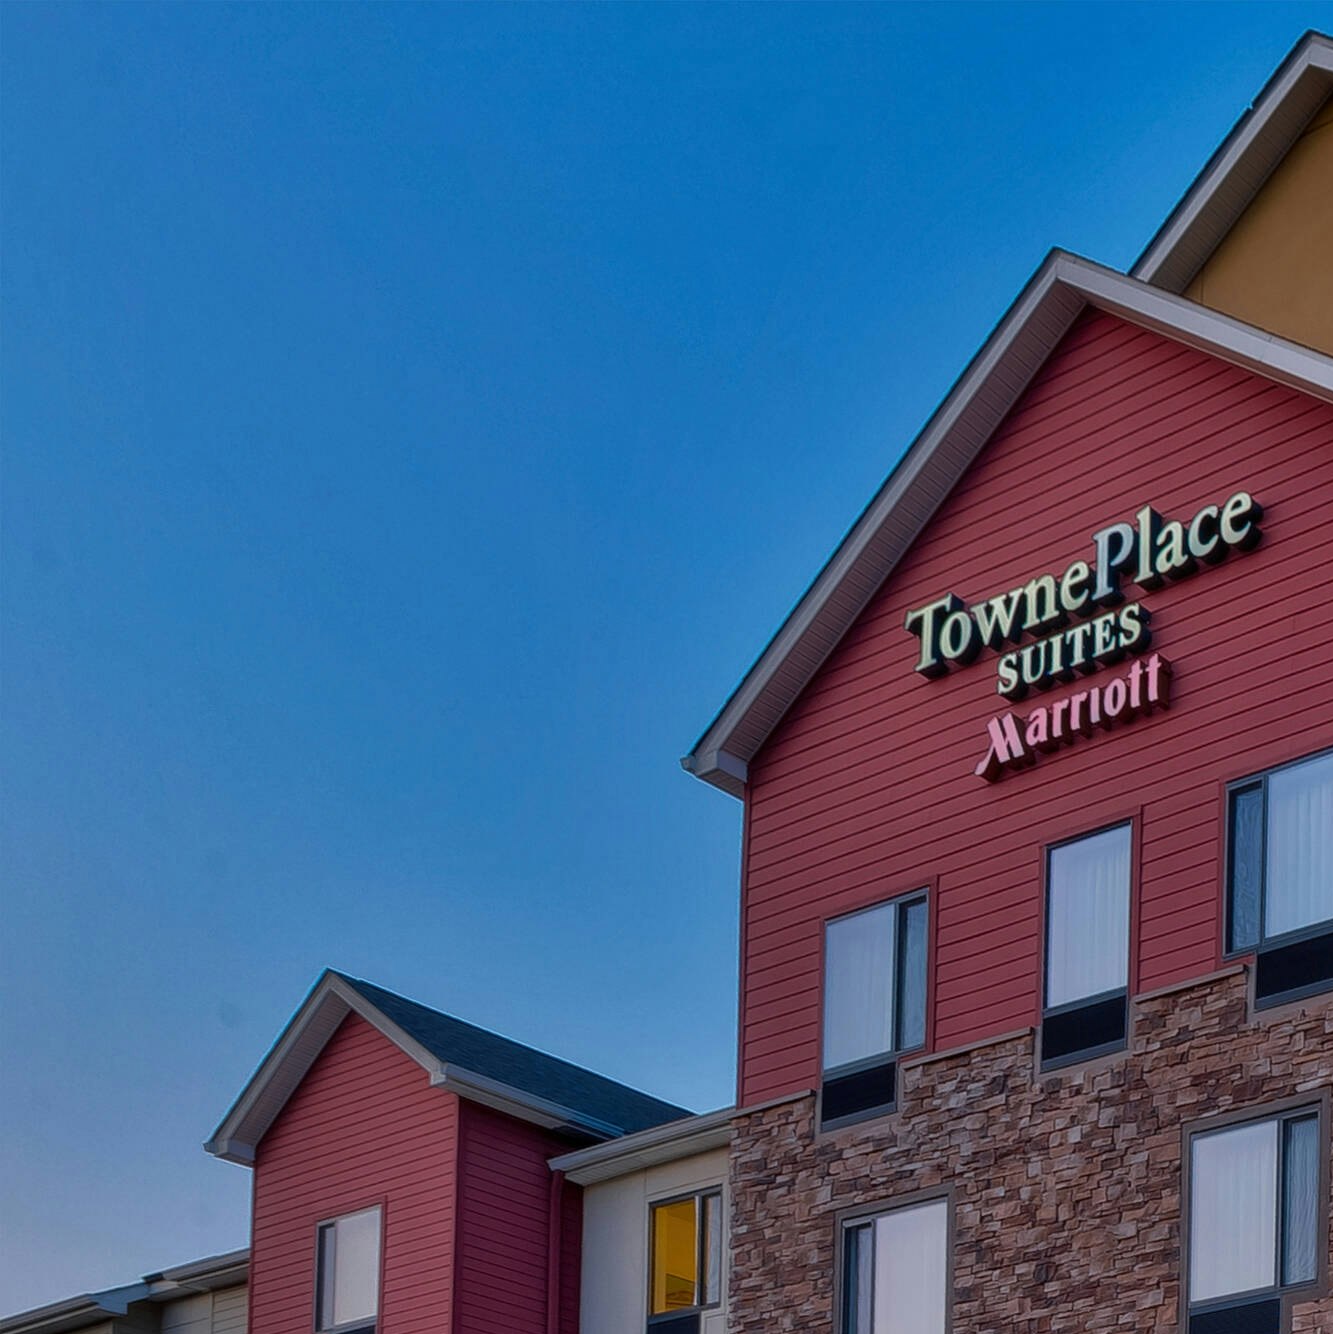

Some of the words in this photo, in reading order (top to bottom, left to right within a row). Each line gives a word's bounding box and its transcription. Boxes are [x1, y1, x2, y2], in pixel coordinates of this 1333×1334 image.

[904, 491, 1259, 675] TownePlace
[997, 602, 1147, 697] SUITES
[974, 652, 1166, 780] Marriott
